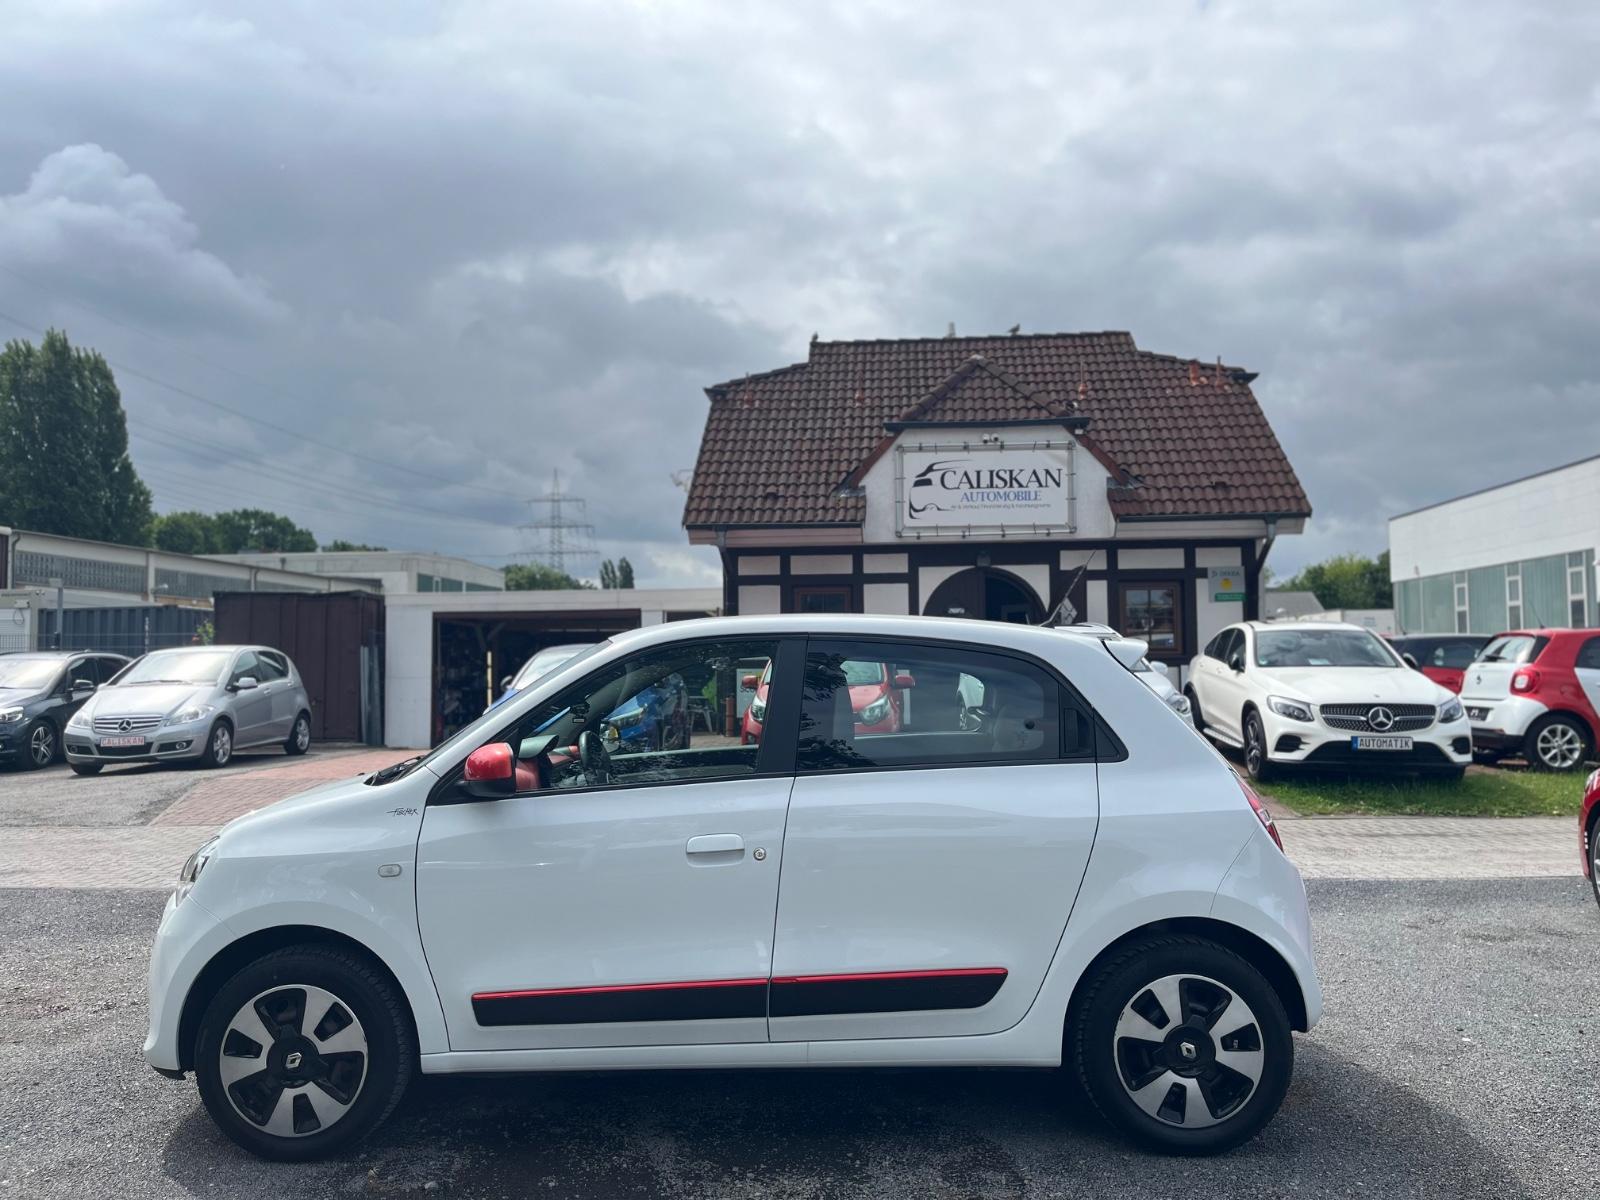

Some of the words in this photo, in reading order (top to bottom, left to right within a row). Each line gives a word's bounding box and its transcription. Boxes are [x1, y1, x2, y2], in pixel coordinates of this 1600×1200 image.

[940, 468, 1063, 490] CALISKAN
[960, 490, 1042, 502] AUTOMOBILE
[101, 737, 144, 746] CALISKAN
[1359, 738, 1410, 749] AUTOMATIK
